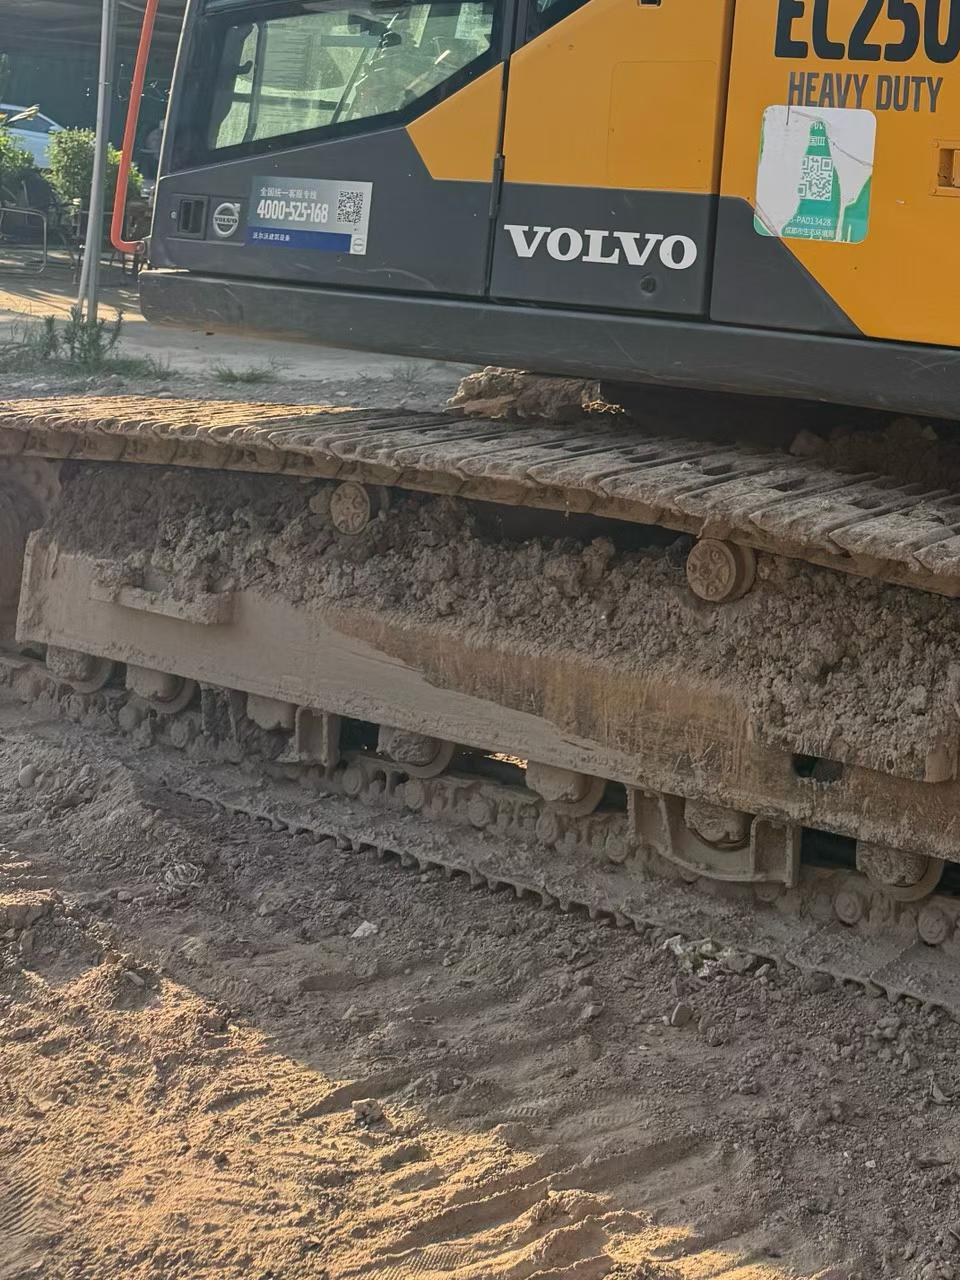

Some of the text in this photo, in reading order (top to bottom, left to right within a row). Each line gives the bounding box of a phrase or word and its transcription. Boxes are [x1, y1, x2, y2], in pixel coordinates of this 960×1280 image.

[788, 71, 943, 112] HEAVY DUTY
[214, 216, 238, 224] VOLVO
[257, 199, 329, 224] 4000-525-168
[504, 224, 698, 270] VOLVO
